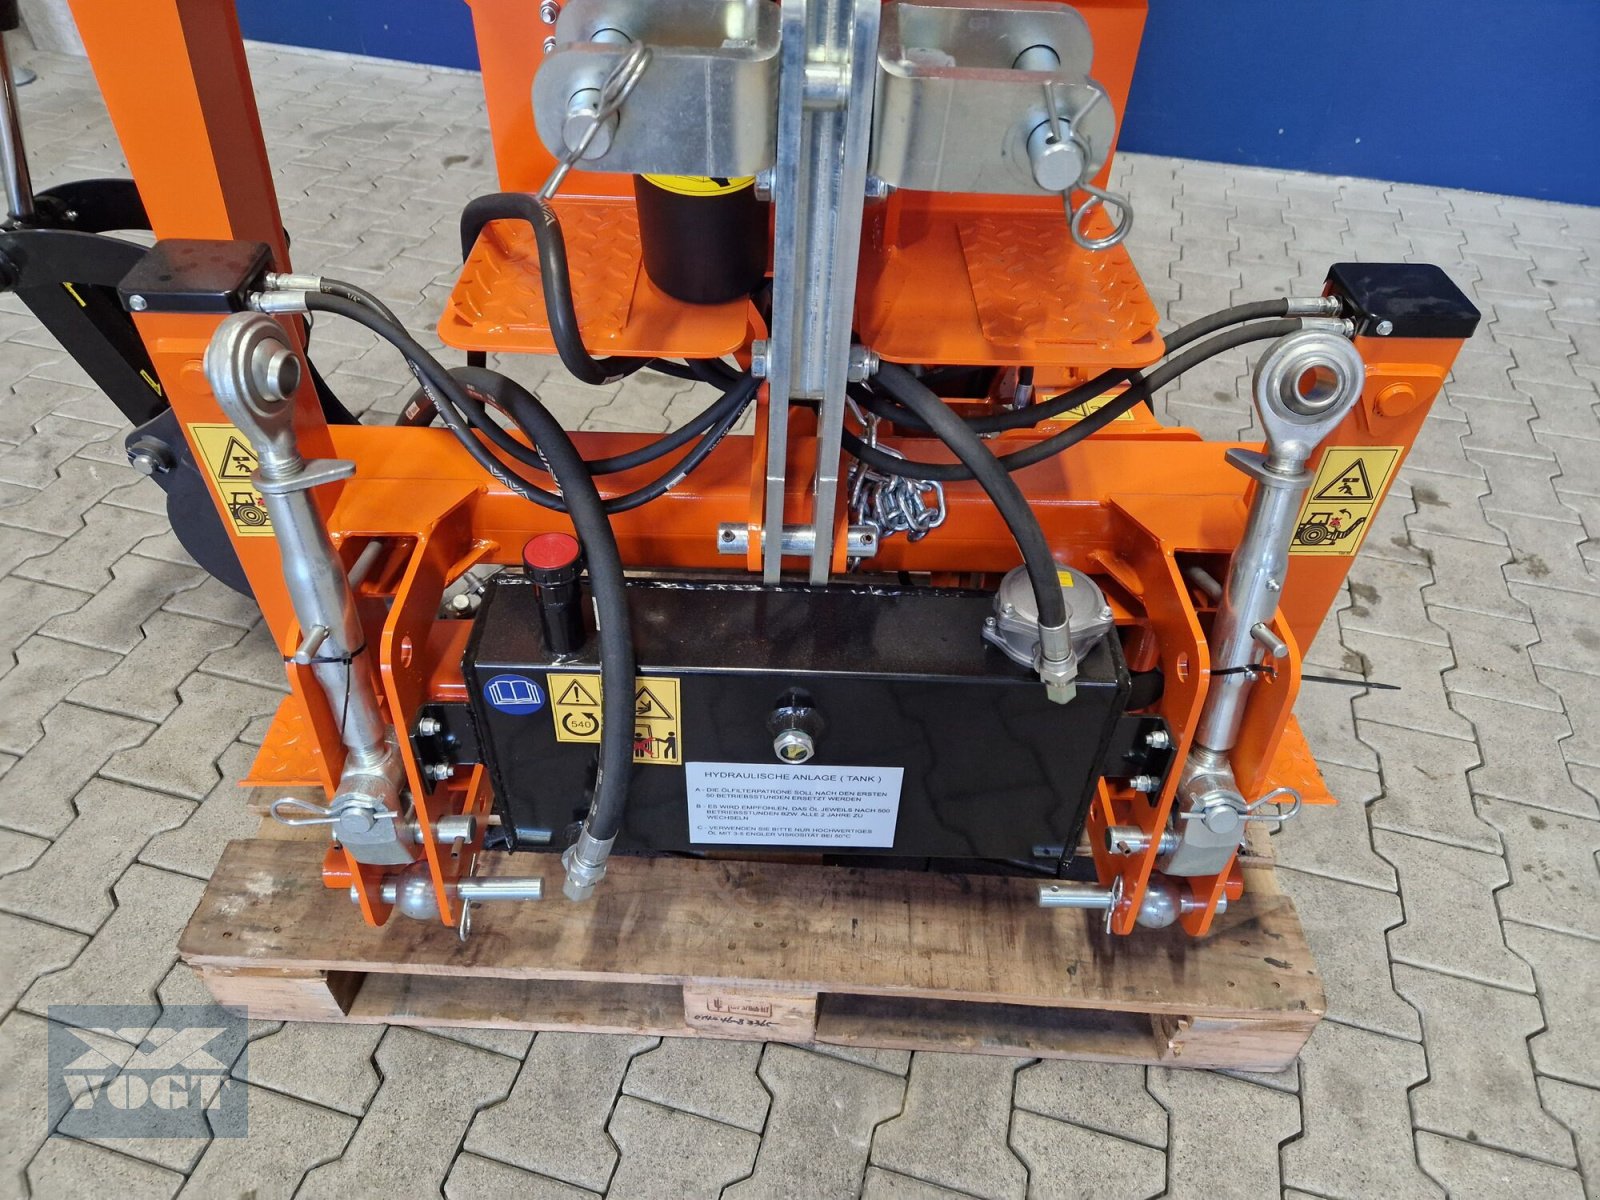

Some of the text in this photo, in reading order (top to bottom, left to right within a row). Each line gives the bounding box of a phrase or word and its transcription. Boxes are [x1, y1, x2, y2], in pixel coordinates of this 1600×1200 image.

[571, 720, 591, 728] 540
[704, 772, 790, 780] HYDRAULISCHE
[792, 774, 837, 782] ANLAGE
[846, 775, 876, 783] TANK
